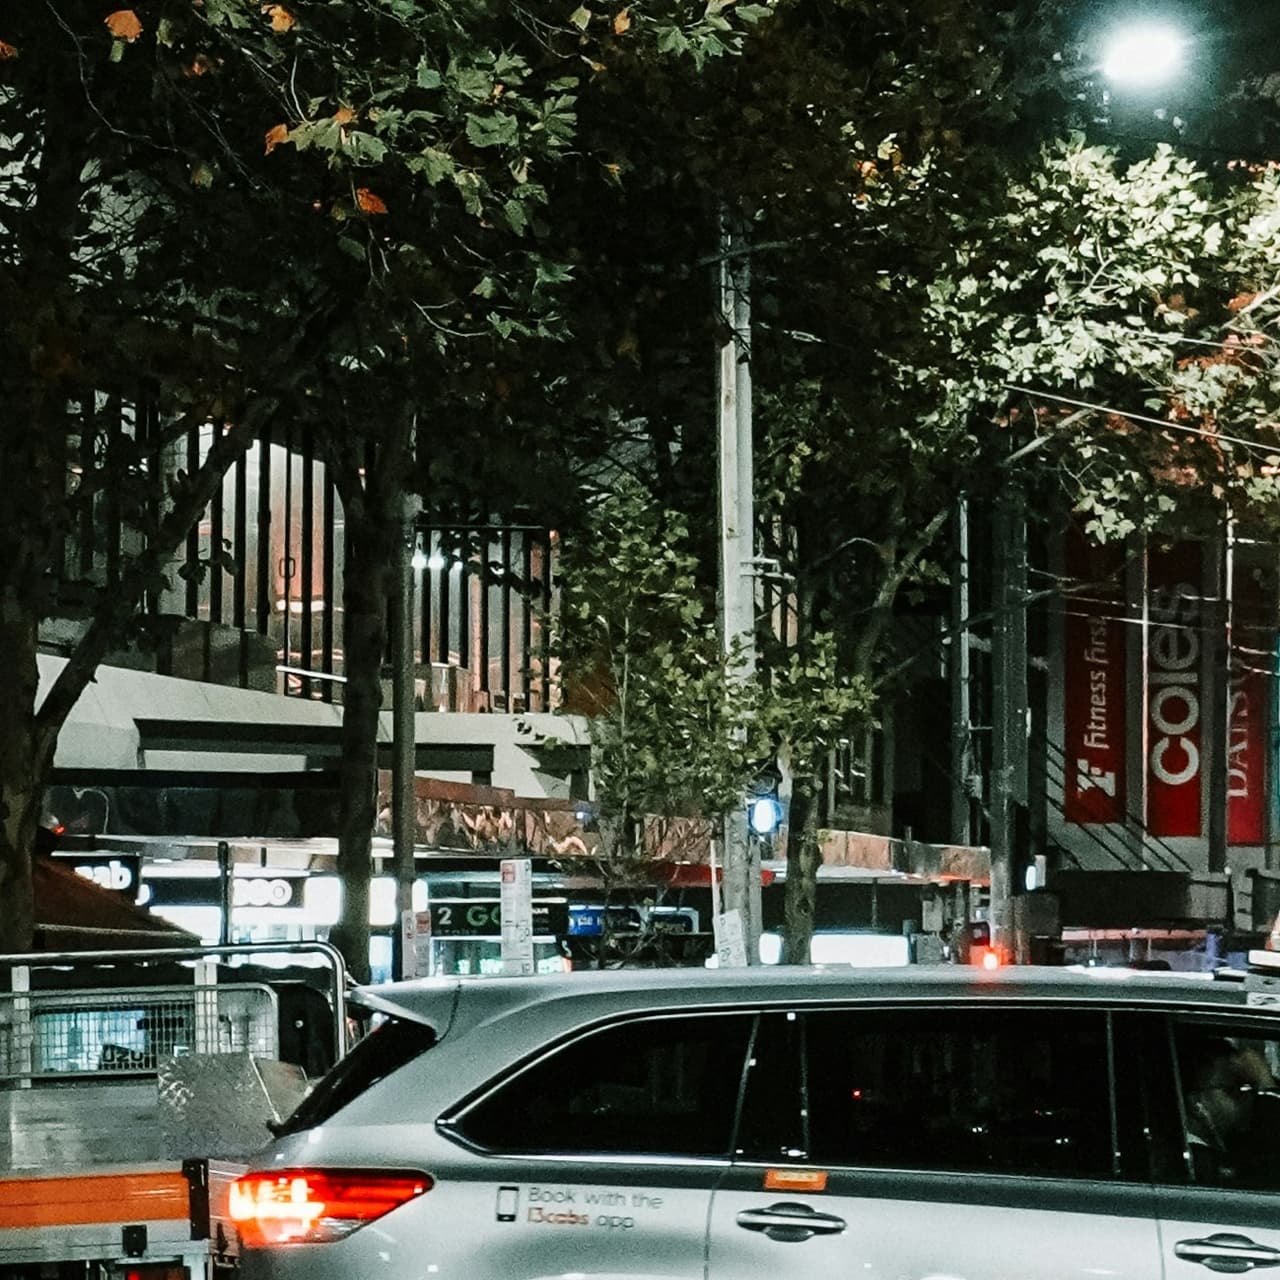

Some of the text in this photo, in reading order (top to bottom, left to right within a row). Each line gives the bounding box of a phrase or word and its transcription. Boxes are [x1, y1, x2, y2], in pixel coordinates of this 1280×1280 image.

[1150, 582, 1201, 786] coles
[1083, 669, 1110, 750] fitness
[438, 906, 453, 926] 2
[527, 1186, 664, 1210] Book with the
[527, 1206, 636, 1230] 13cabs app
